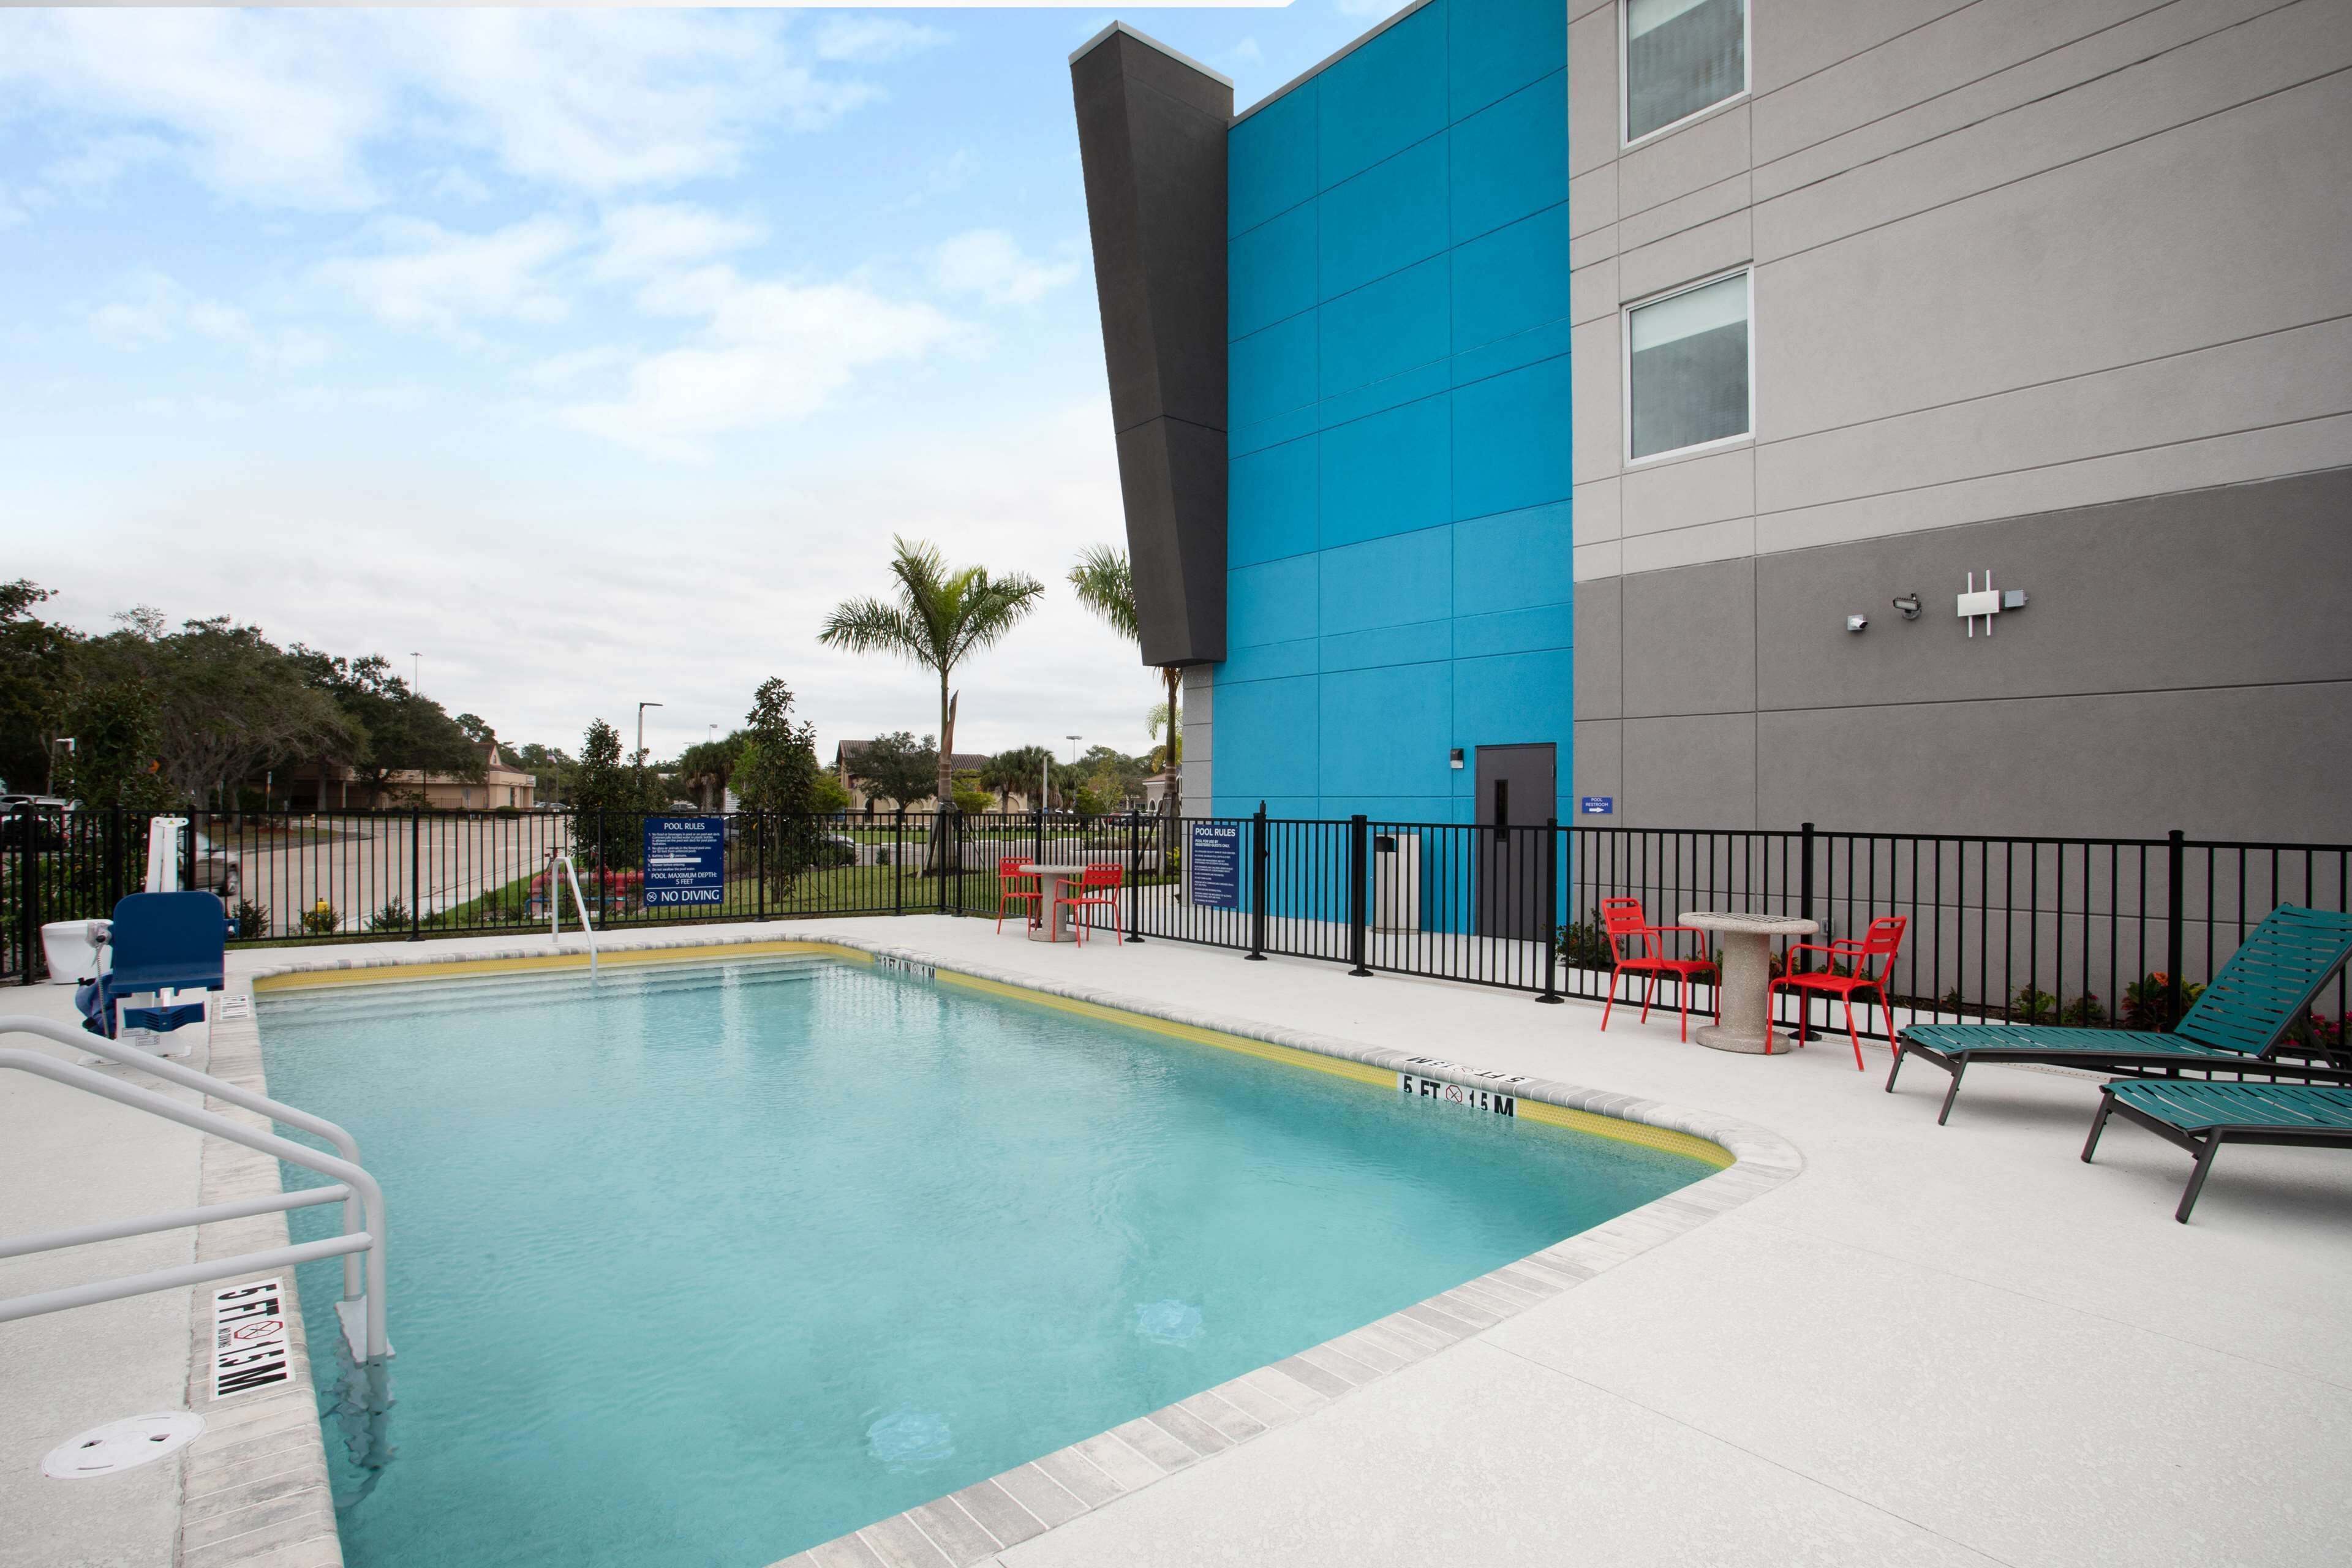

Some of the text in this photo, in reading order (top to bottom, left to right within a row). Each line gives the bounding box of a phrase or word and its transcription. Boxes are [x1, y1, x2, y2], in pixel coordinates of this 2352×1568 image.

[1195, 827, 1235, 837] POOL RULES
[661, 889, 720, 902] NO DIVING
[889, 958, 896, 970] FT
[904, 962, 911, 973] IN
[929, 967, 935, 979] M
[1403, 1075, 1412, 1093] 5
[1420, 1079, 1441, 1099] FT
[1494, 1095, 1513, 1117] M
[217, 1283, 277, 1300] 5
[219, 1297, 280, 1324] FT
[218, 1360, 287, 1396] M
